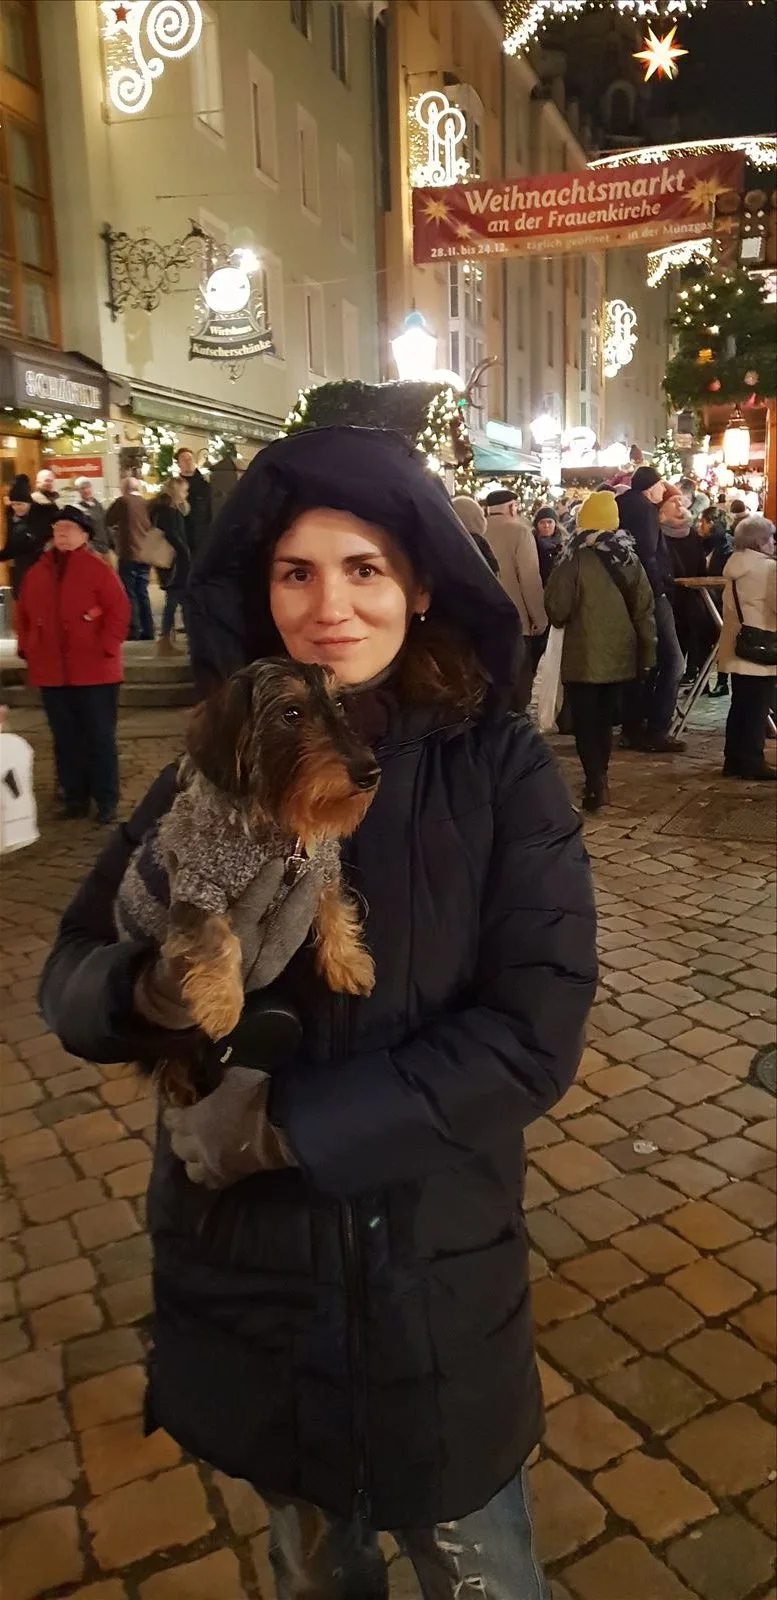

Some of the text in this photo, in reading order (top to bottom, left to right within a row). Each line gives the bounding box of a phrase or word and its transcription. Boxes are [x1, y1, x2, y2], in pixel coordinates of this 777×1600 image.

[464, 168, 686, 214] Weihnachtsmarkt
[487, 200, 662, 233] an der Frauenkirche
[461, 244, 477, 255] bis
[627, 229, 639, 240] in
[641, 226, 660, 239] der
[192, 340, 273, 357] Kutscherschänke
